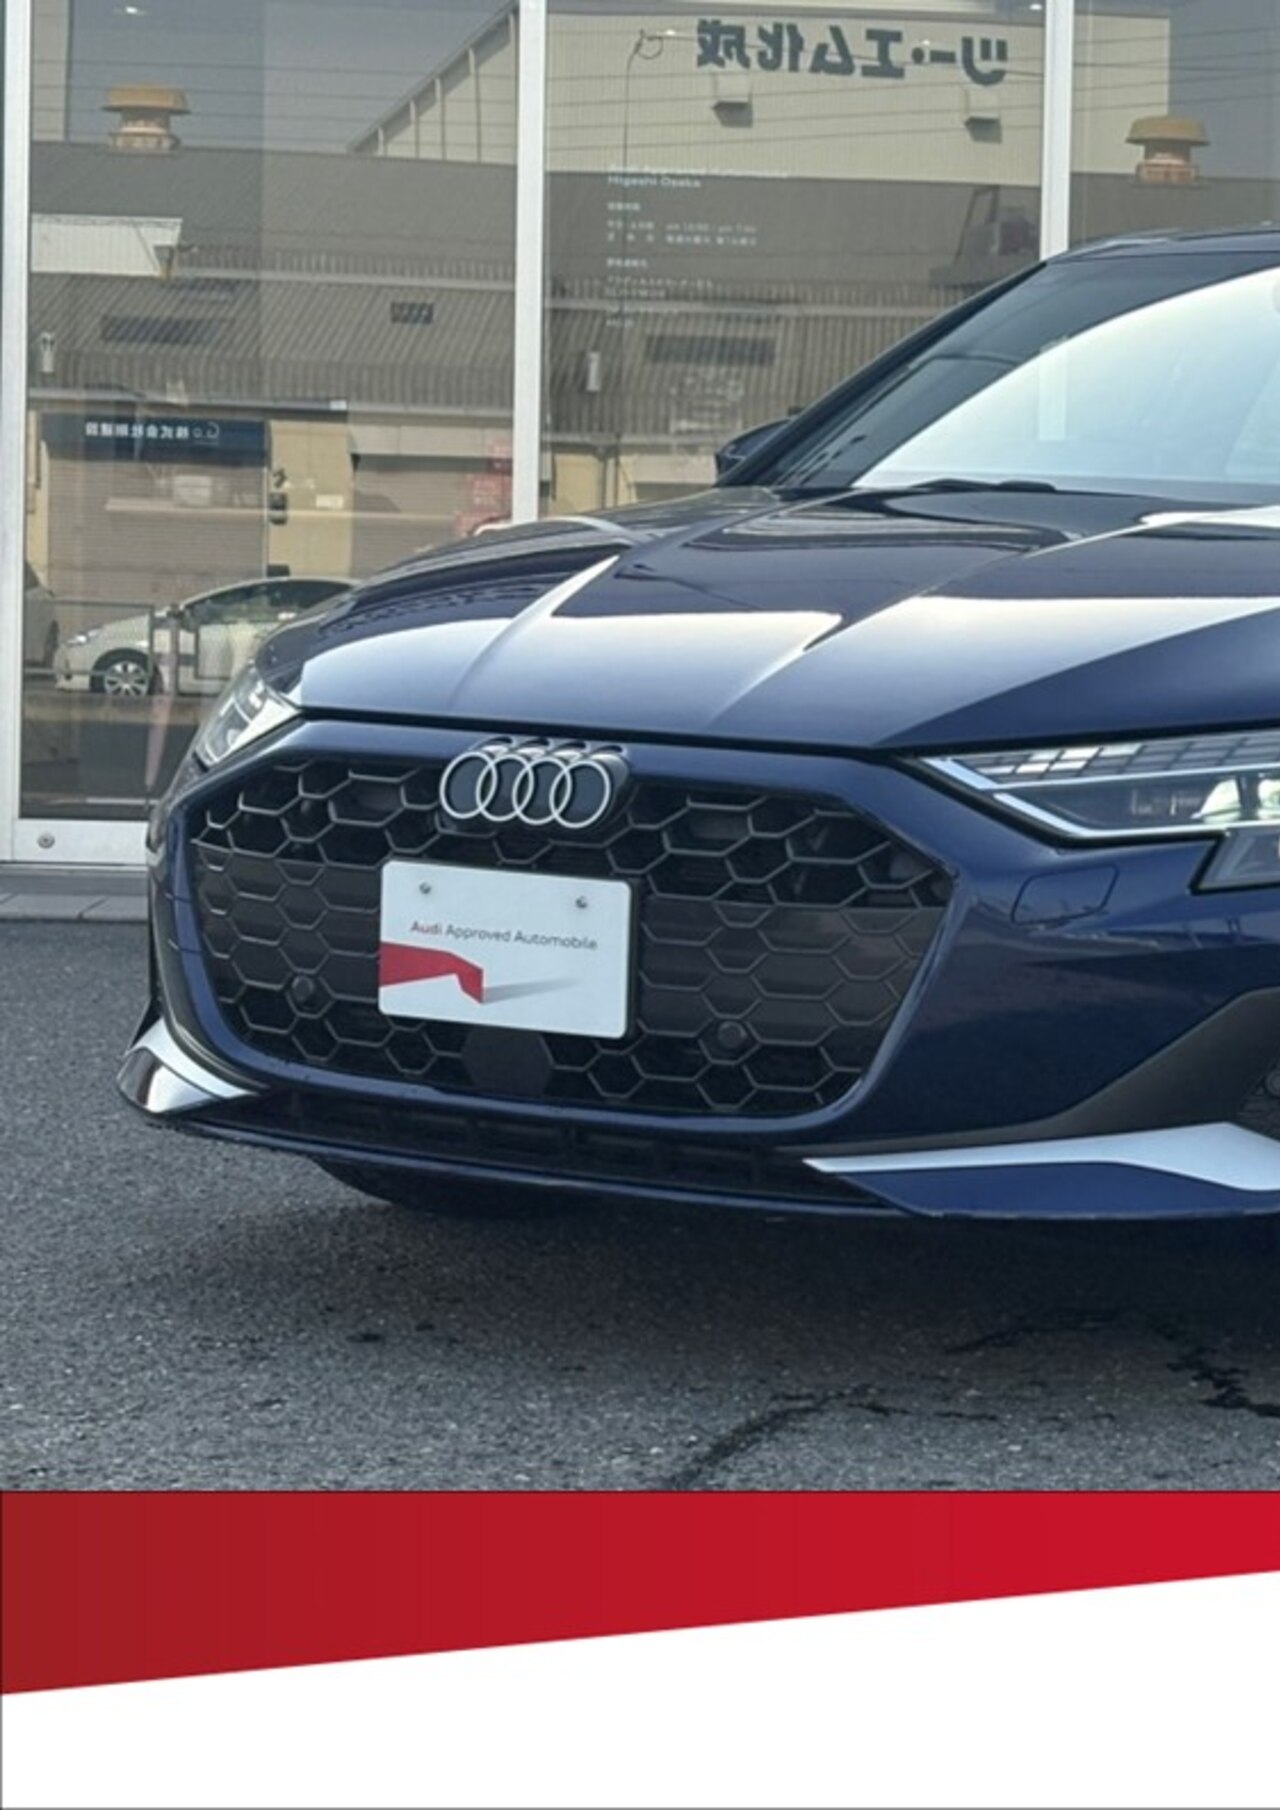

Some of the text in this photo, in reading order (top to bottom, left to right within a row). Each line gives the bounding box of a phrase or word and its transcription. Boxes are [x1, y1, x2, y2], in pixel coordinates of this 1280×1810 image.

[410, 920, 598, 950] Audi Approved Automobile
